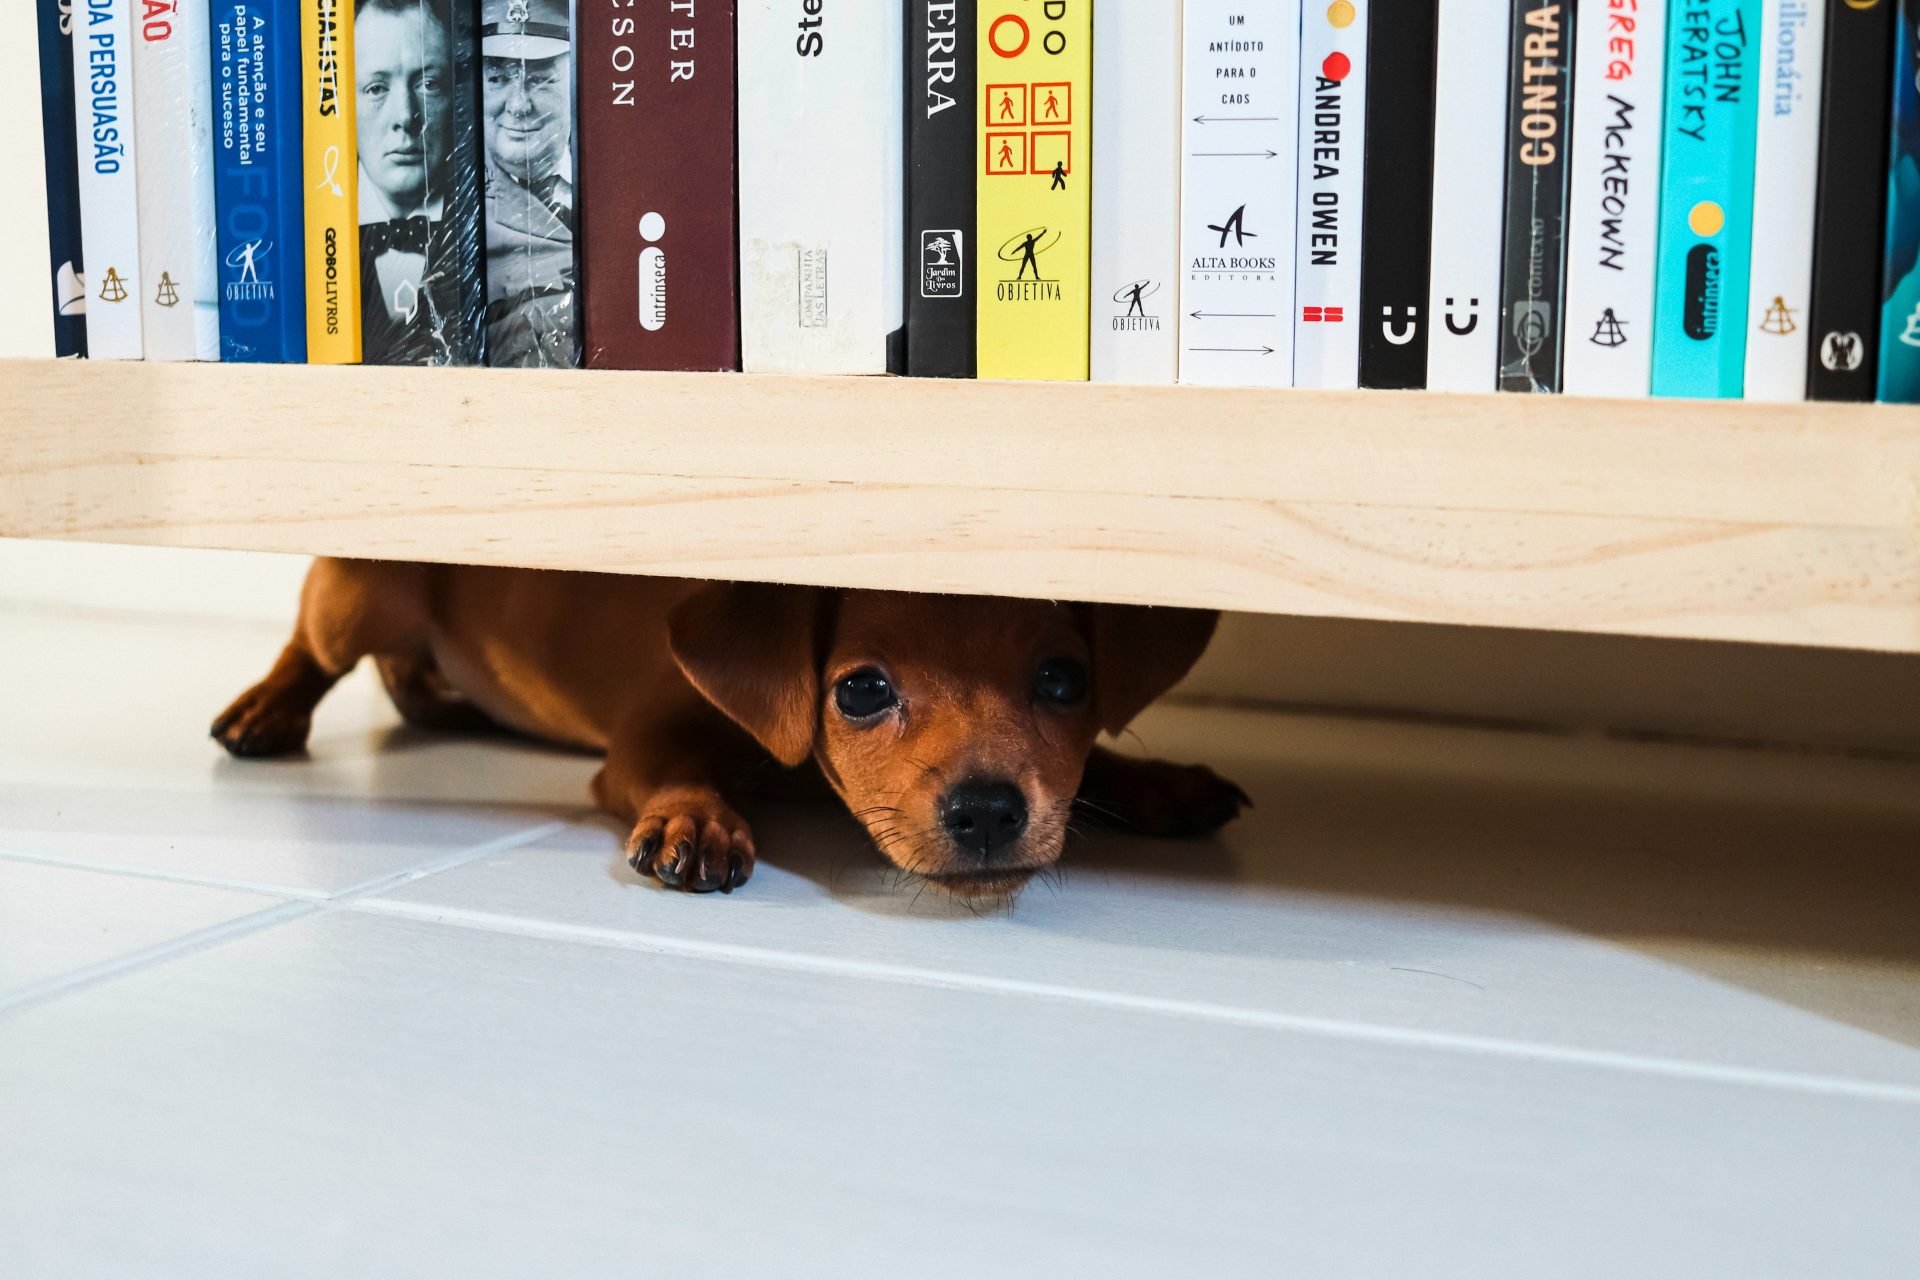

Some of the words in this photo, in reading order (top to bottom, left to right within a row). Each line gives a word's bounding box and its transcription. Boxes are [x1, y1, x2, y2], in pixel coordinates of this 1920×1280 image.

[234, 5, 249, 53] papel
[252, 16, 266, 30] A
[796, 0, 824, 57] Ste
[1229, 15, 1245, 26] UM
[219, 23, 231, 61] para
[1209, 40, 1264, 52] ANTÍDOTO
[927, 0, 957, 119] ERRA
[1713, 9, 1746, 103] JOHN
[222, 66, 231, 78] o
[252, 35, 267, 103] atenção
[1216, 68, 1245, 78] PARA
[1250, 68, 1256, 78] O
[1519, 4, 1560, 165] CONTRA
[89, 34, 124, 174] PERSUASÃO
[1222, 94, 1250, 105] CAOS
[222, 83, 233, 149] sucesso
[237, 58, 252, 165] fundamental
[254, 107, 265, 118] e
[255, 123, 266, 152] seu
[1313, 76, 1341, 180] ANDREA
[1311, 192, 1339, 265] OWEN
[925, 267, 956, 281] Jardim
[1192, 258, 1226, 268] ALTA
[1230, 257, 1275, 269] BOOKS
[226, 283, 275, 300] OBJETIVA
[925, 280, 956, 293] Livros
[997, 283, 1061, 301] OBJETIVA
[1112, 318, 1160, 331] OBJETIVA
